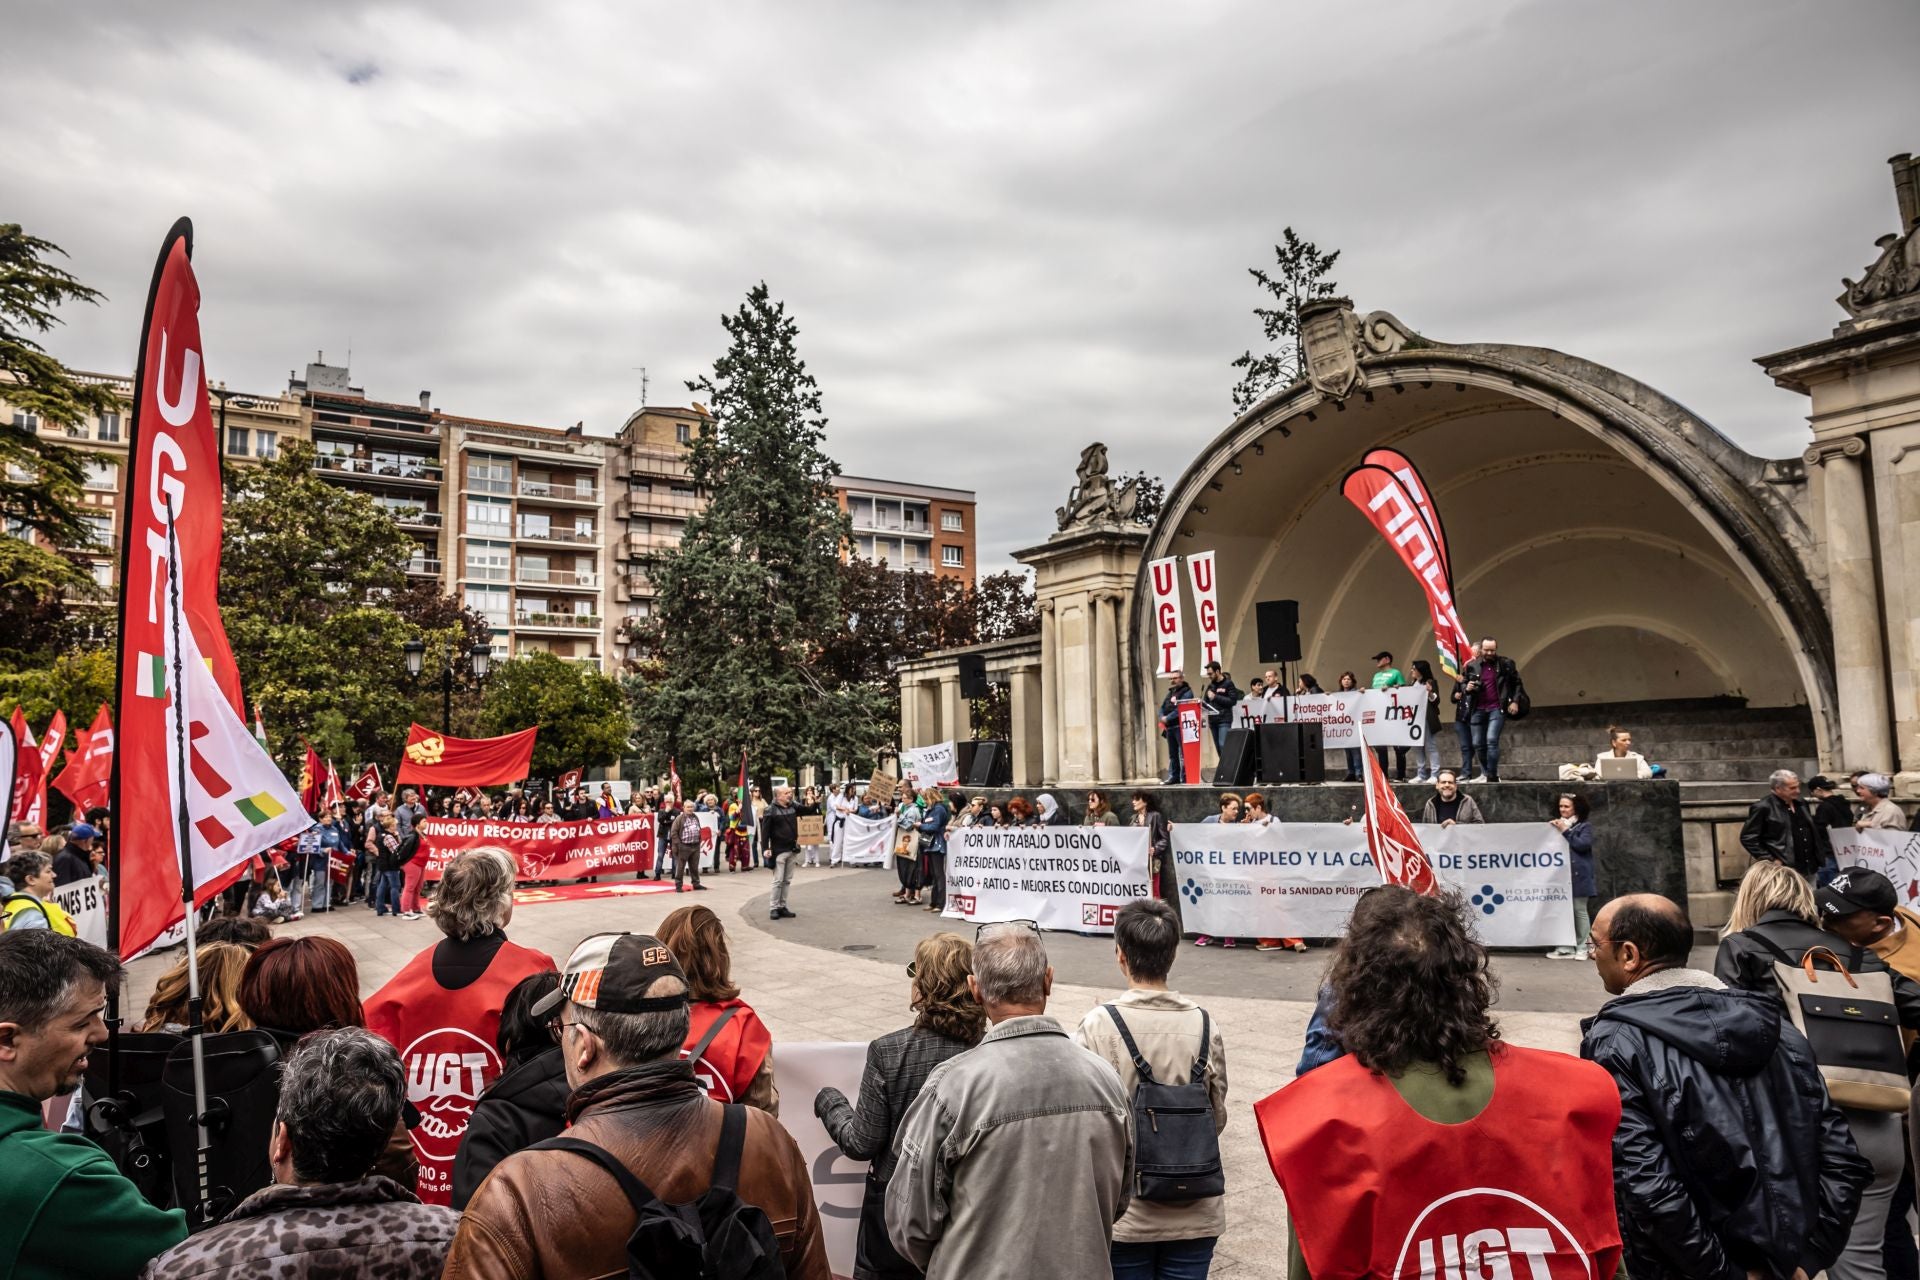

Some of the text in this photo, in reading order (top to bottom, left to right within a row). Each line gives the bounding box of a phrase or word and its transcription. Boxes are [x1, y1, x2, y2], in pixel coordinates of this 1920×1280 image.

[147, 327, 200, 624] UGT
[1153, 563, 1177, 673] UGT
[1193, 559, 1217, 662] UGT
[1293, 700, 1345, 715] Proteger lo
[484, 824, 545, 840] RECORTE
[549, 826, 577, 840] POR
[578, 824, 594, 837] LA
[597, 818, 651, 835] GUERRA
[565, 840, 649, 862] ¡VIVA EL PRIMERO
[964, 833, 1102, 850] POR UN TRABAJO DIGNO
[585, 858, 600, 869] DE
[954, 856, 963, 868] EN
[963, 856, 1021, 870] RESIDENCIAS
[1029, 858, 1079, 872] CENTROS
[1082, 859, 1098, 872] DE
[1101, 856, 1121, 874] DÍA
[1176, 850, 1204, 865] POR
[1209, 850, 1226, 865] EL
[1233, 851, 1302, 866] EMPLEO
[1307, 852, 1318, 866] Y
[1323, 852, 1344, 866] LA
[1440, 854, 1463, 870] DE
[1467, 852, 1564, 870] SERVICIOS
[983, 877, 1010, 890] RATIO
[1021, 879, 1066, 893] MEJORES
[1068, 881, 1148, 897] CONDICIONES
[1202, 882, 1252, 890] HOSPITAL
[1260, 886, 1276, 895] Por
[1278, 886, 1287, 895] la
[1289, 886, 1333, 896] SANIDAD
[84, 884, 97, 911] ES
[1825, 902, 1839, 914] UGT
[407, 1052, 489, 1102] UGT
[440, 1171, 447, 1181] a
[1419, 1227, 1556, 1280] UGT
